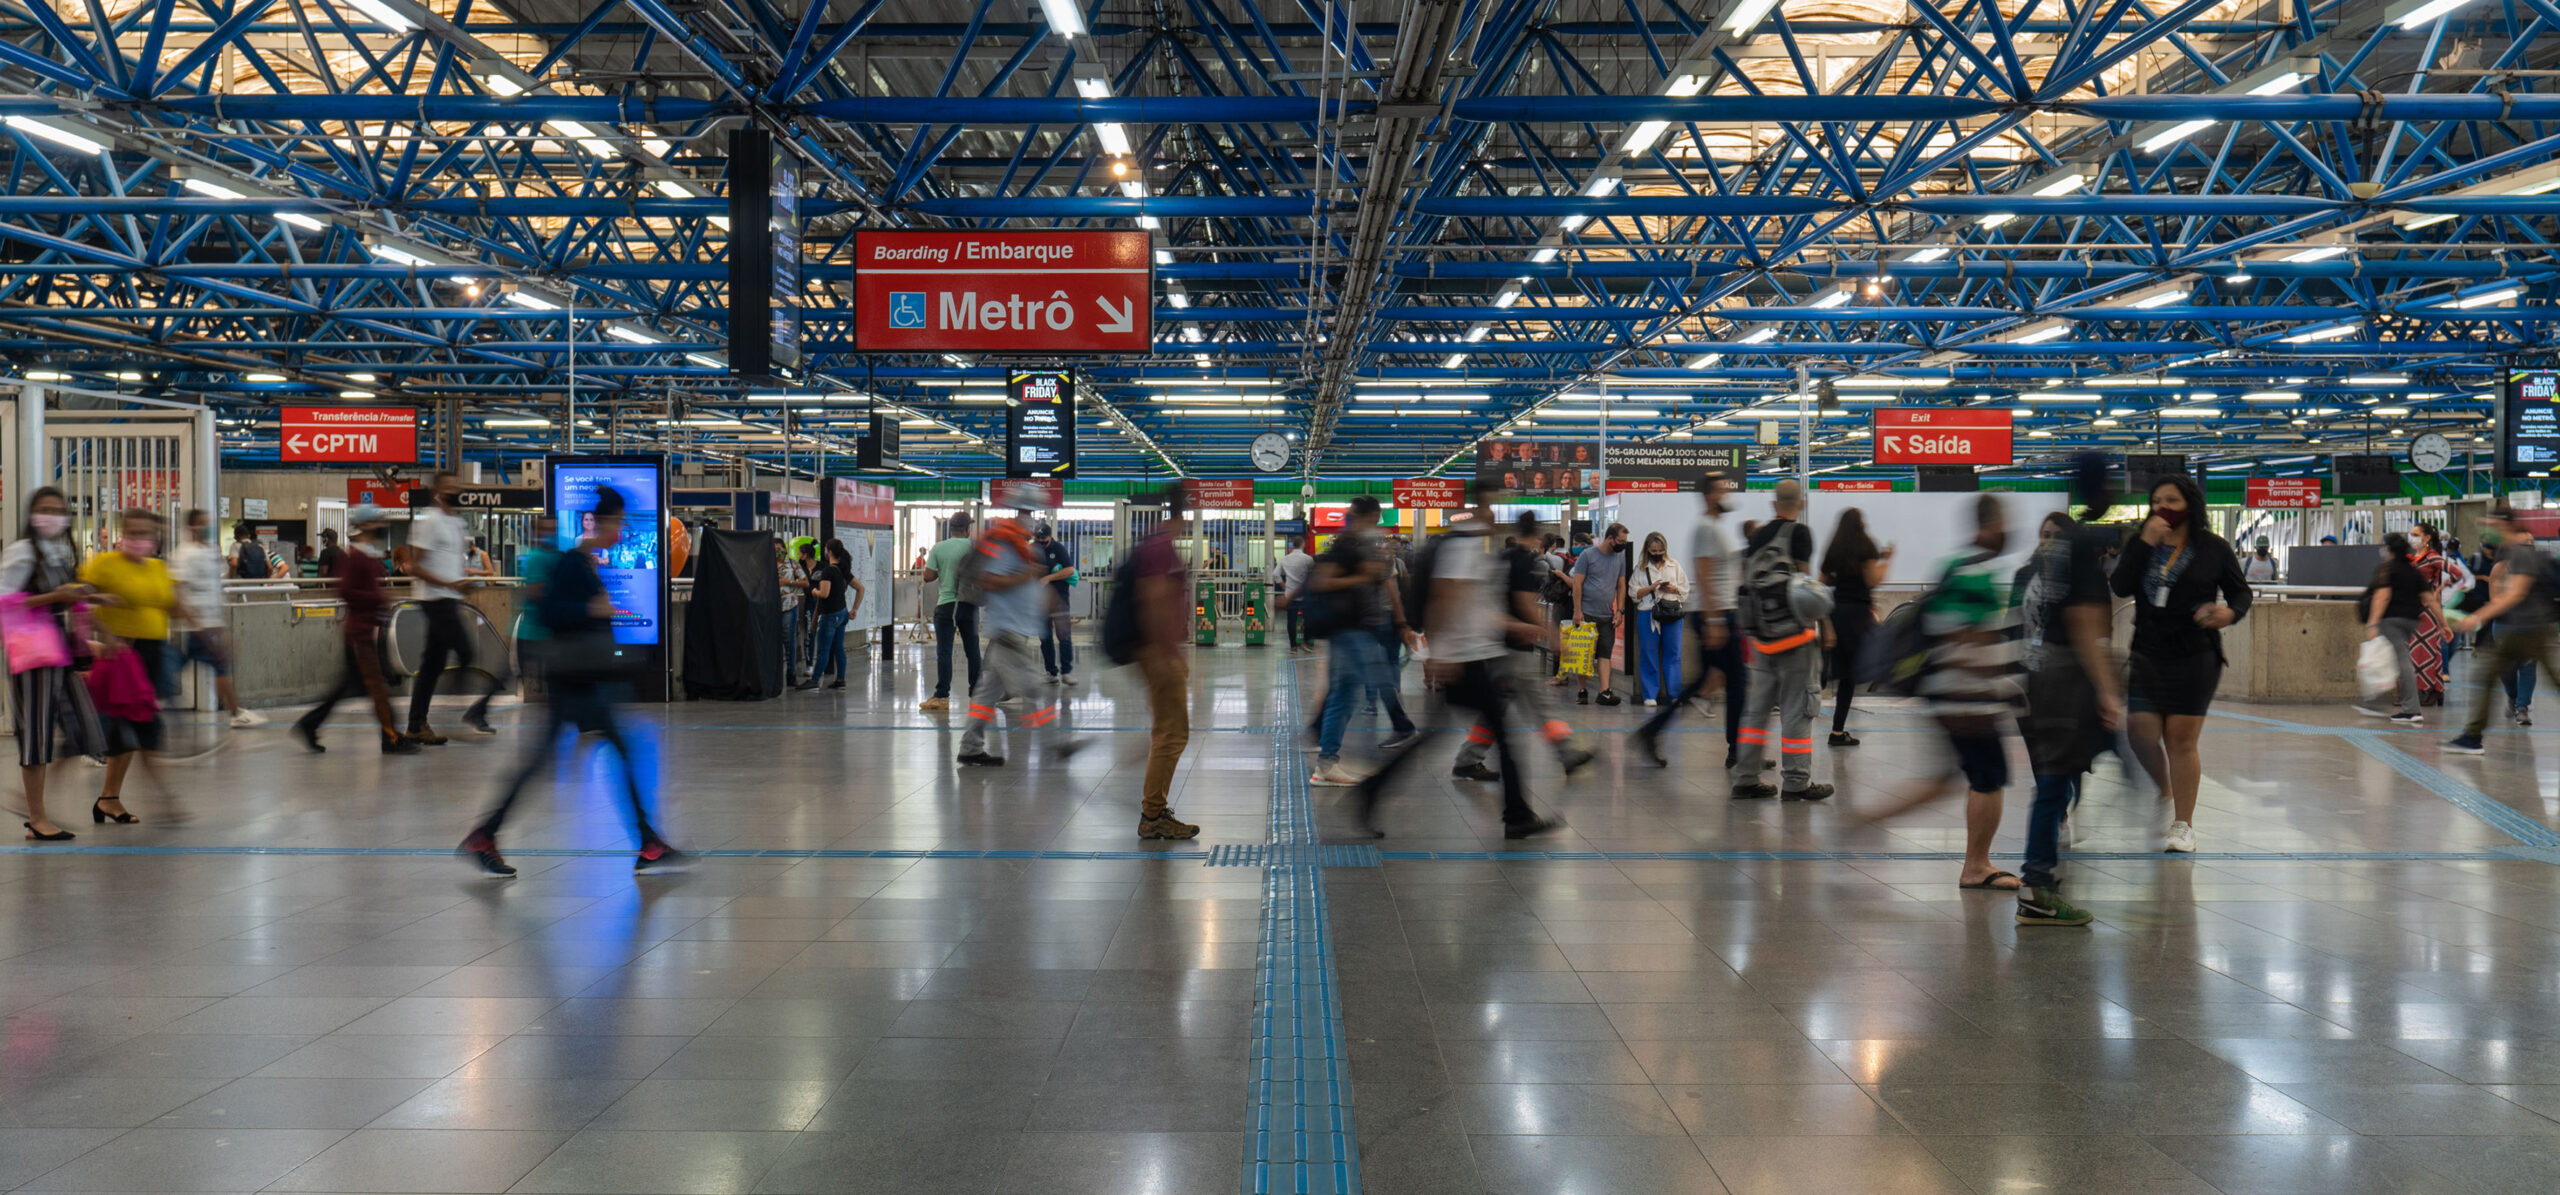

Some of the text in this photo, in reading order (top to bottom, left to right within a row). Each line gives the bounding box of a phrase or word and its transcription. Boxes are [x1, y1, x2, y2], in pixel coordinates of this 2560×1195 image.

[874, 241, 1074, 263] Boarding / Embarque
[939, 290, 1075, 330] Metrô
[1035, 378, 1057, 386] BLACK
[2534, 377, 2556, 385] BLACK
[1024, 386, 1057, 398] FRIDAY
[2523, 385, 2556, 397] FRIDAY
[312, 411, 378, 421] Transferência
[1911, 413, 1931, 423] Exit
[312, 433, 378, 454] CPTM
[1908, 434, 1971, 455] Saída
[1604, 446, 1674, 458] PÓS-GRADUAÇÃO
[1698, 449, 1730, 457] ONLINE
[1200, 490, 1234, 498] Terminal
[1426, 490, 1440, 498] Mq.
[2268, 488, 2304, 496] Terminal
[458, 492, 502, 506] CPTM
[1199, 498, 1242, 507] Rodoviário
[1411, 499, 1426, 507] São
[2258, 498, 2304, 506] Urbano Sul
